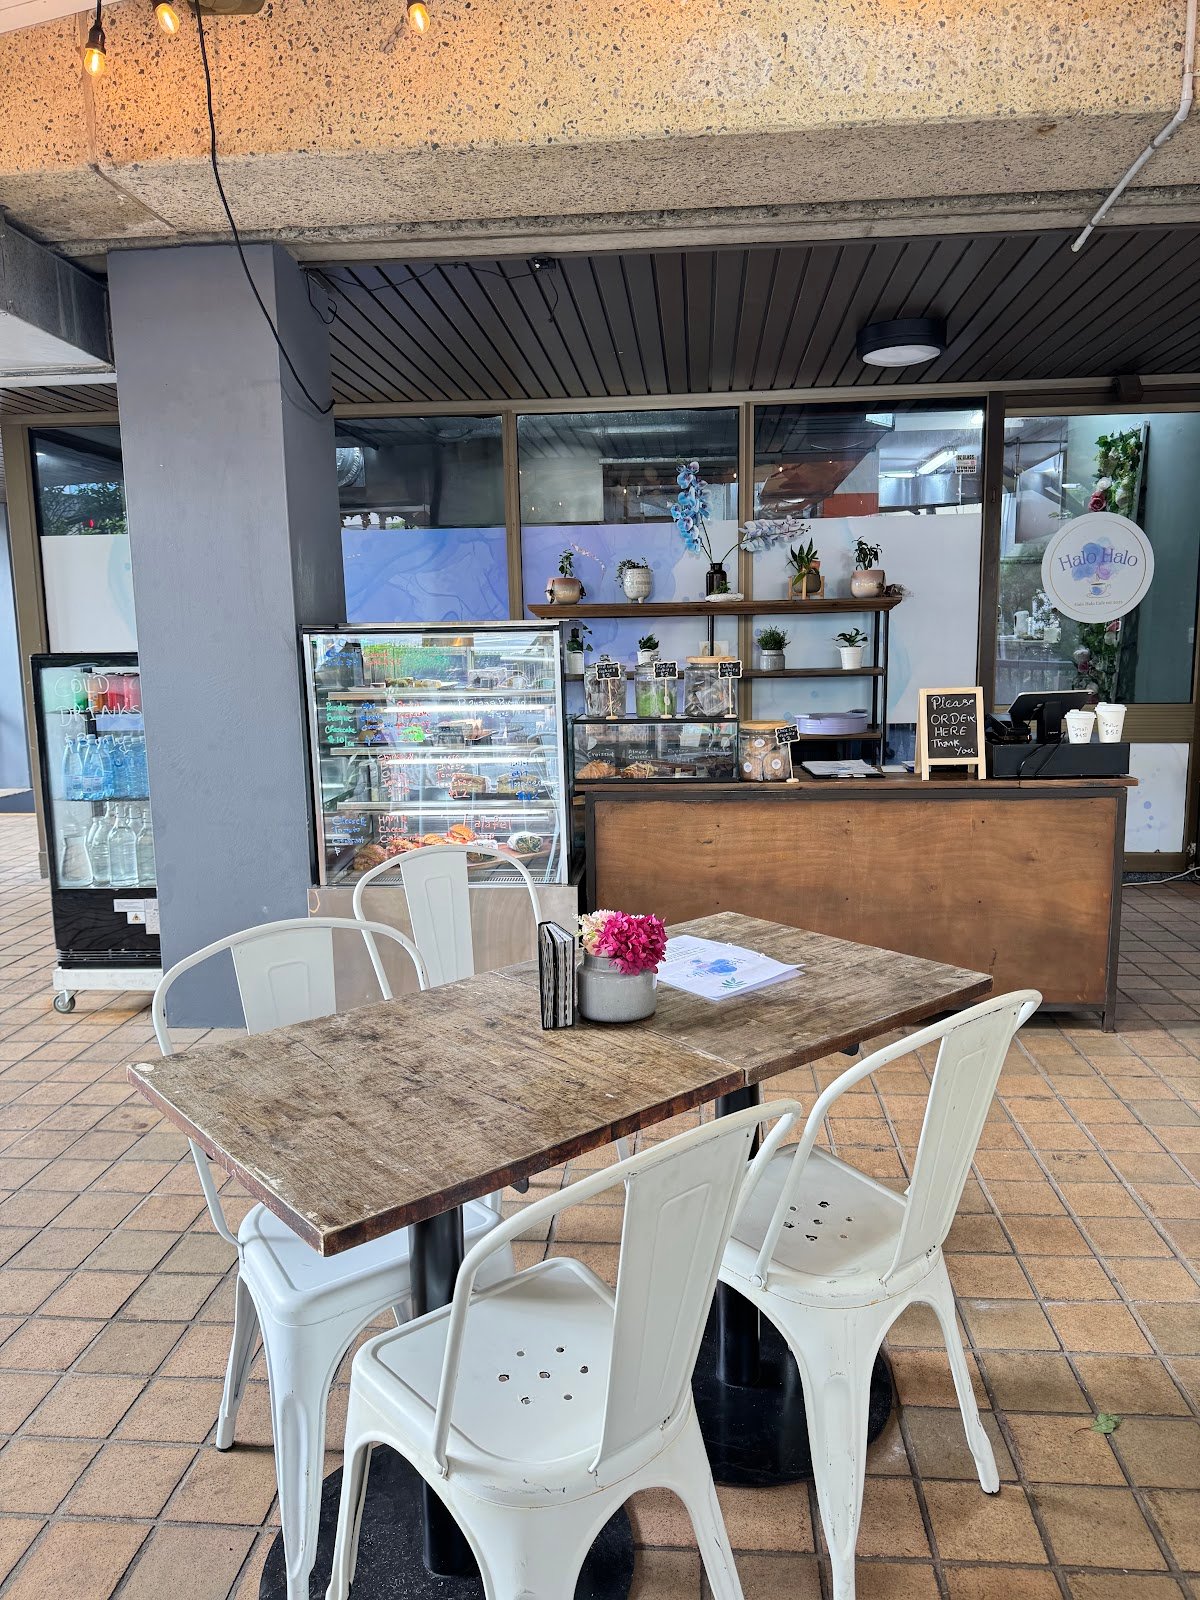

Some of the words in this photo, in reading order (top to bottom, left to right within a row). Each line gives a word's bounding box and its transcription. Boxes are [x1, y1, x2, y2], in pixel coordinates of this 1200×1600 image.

[1058, 550, 1097, 571] Halo
[1102, 547, 1138, 567] Halo
[54, 675, 110, 697] COLD
[931, 696, 974, 710] Please
[56, 704, 142, 727] DRINKS
[930, 712, 976, 725] ORDER
[934, 726, 967, 737] HERE
[931, 738, 960, 748] Thank
